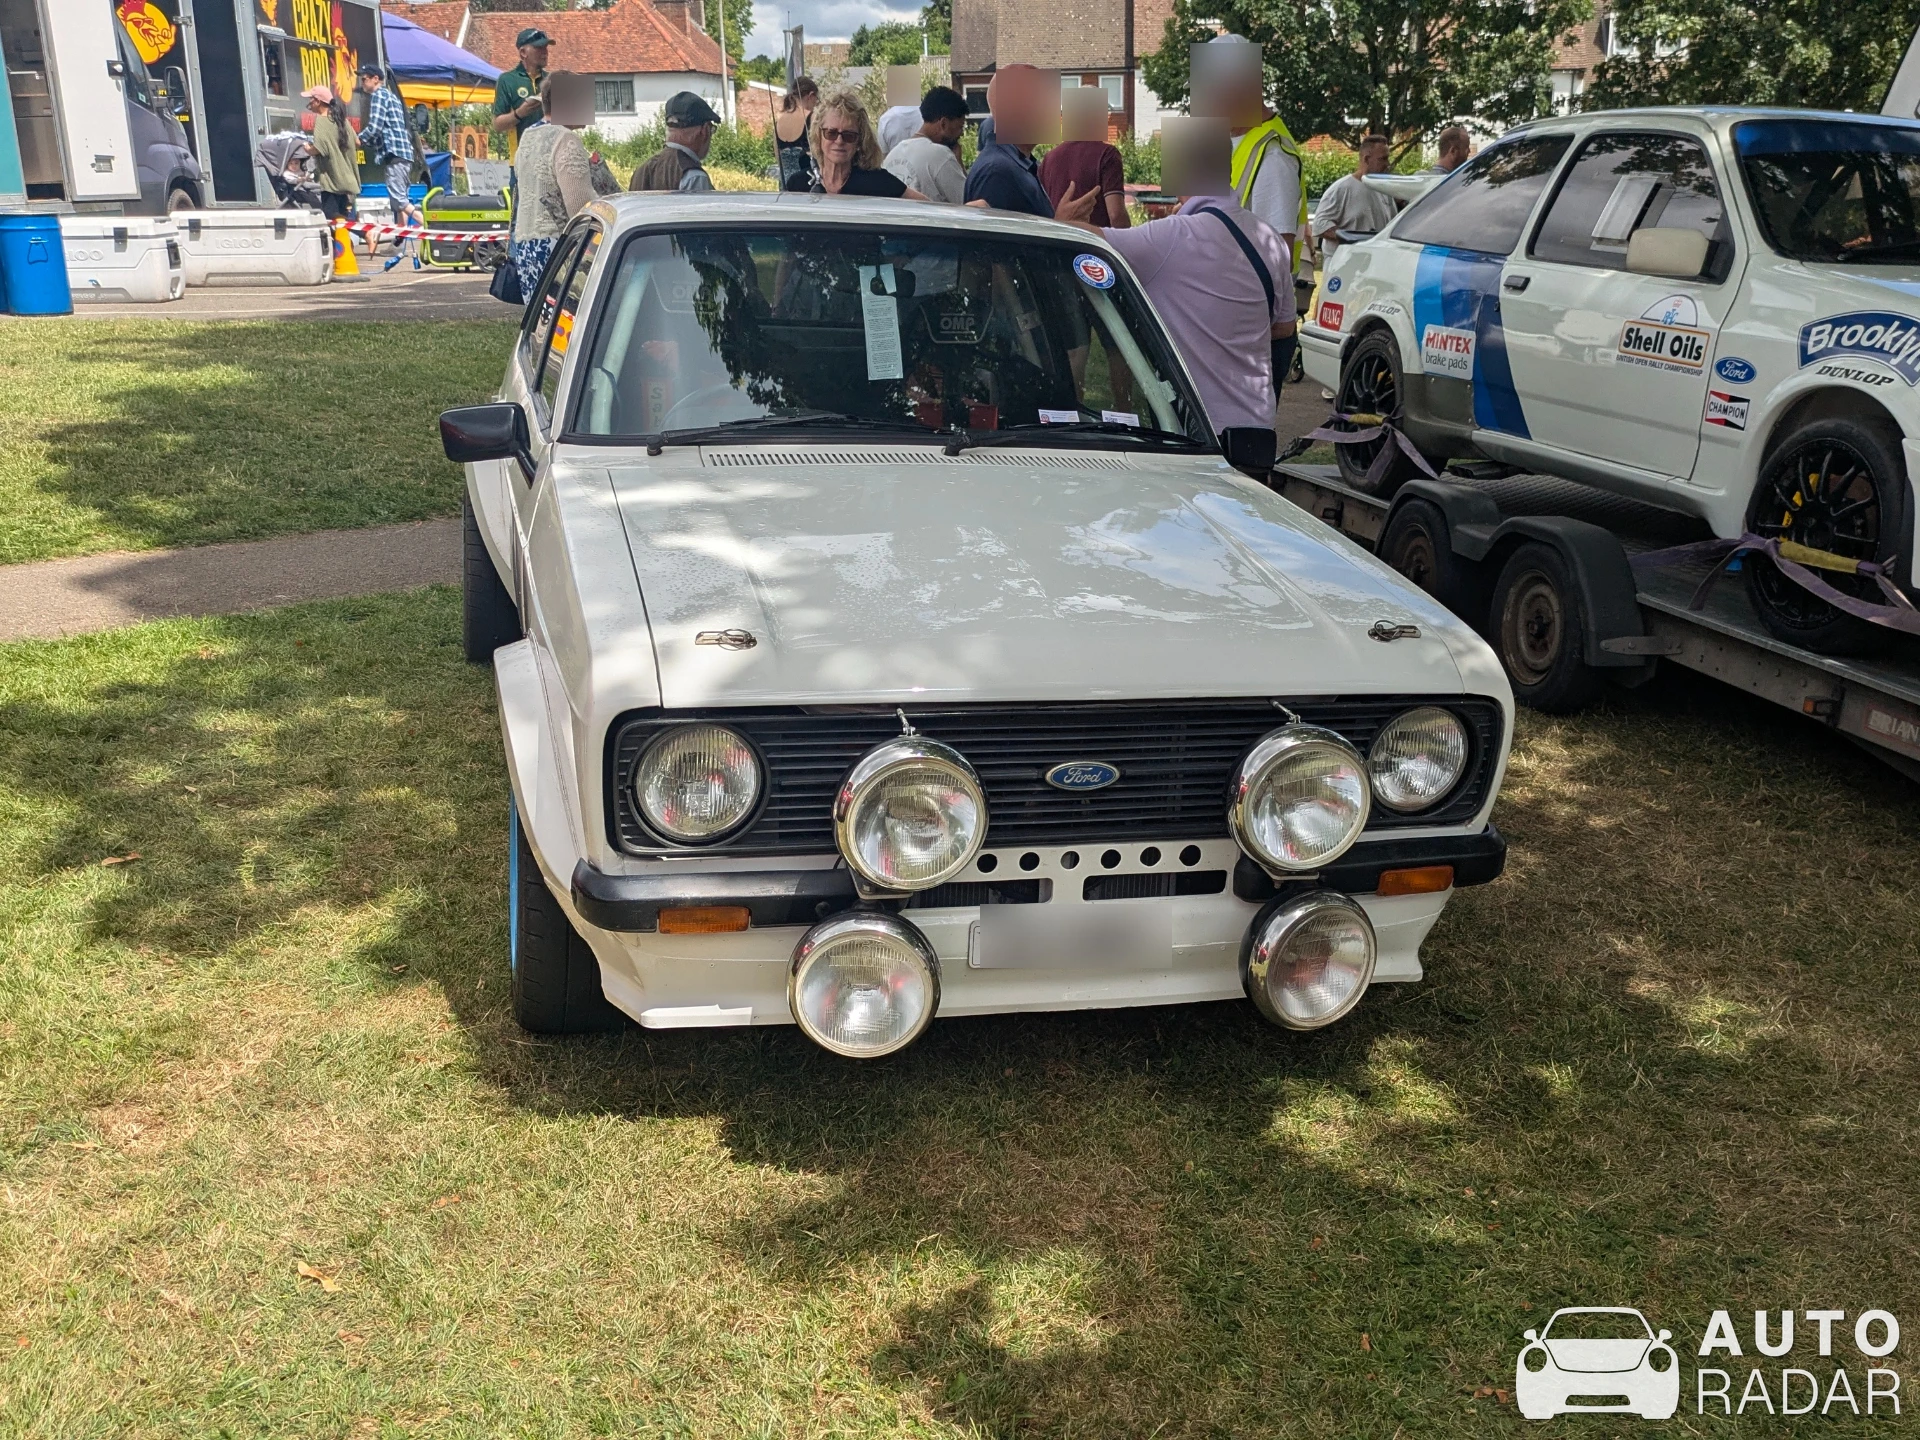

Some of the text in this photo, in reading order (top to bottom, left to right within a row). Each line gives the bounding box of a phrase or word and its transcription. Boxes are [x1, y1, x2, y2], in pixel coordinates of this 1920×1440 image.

[292, 0, 332, 46] CRAZY
[300, 47, 331, 92] BIRD
[215, 237, 265, 249] IGLOO
[1322, 307, 1341, 325] WANG
[1368, 303, 1401, 315] DUNLOP
[940, 317, 974, 330] OMP
[1425, 331, 1472, 354] MINTEX
[1622, 327, 1704, 361] Shell Oils
[1425, 351, 1468, 370] brake pads
[1616, 354, 1703, 376] BRITISH OPEN RALLY CHAMPIONSHIP
[1721, 360, 1748, 380] Ford
[1815, 366, 1895, 386] DUNLOP
[1709, 401, 1745, 419] CHAMPION
[1064, 767, 1103, 783] Ford
